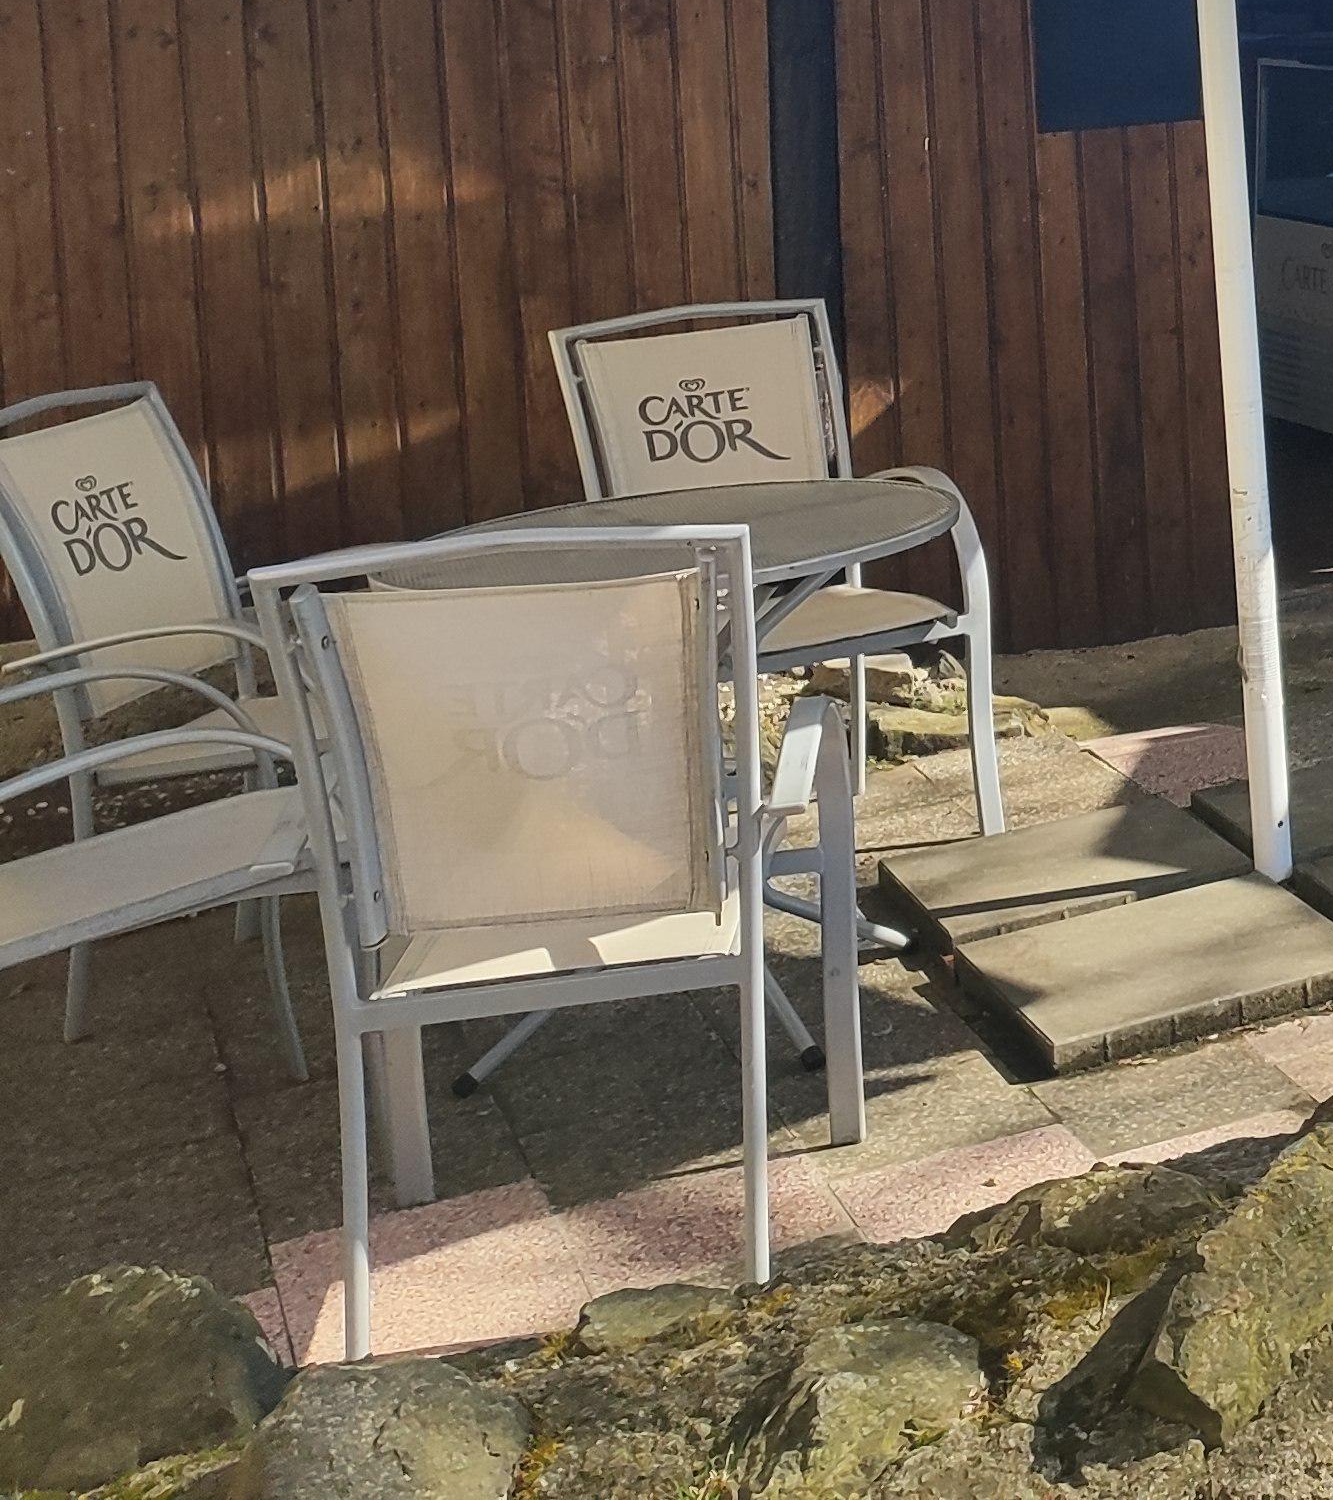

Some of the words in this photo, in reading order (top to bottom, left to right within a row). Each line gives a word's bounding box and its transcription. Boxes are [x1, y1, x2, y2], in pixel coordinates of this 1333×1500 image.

[638, 387, 750, 426] CARTE
[642, 418, 792, 463] D'OR
[50, 481, 139, 535] CARTE
[63, 517, 188, 576] D'OR
